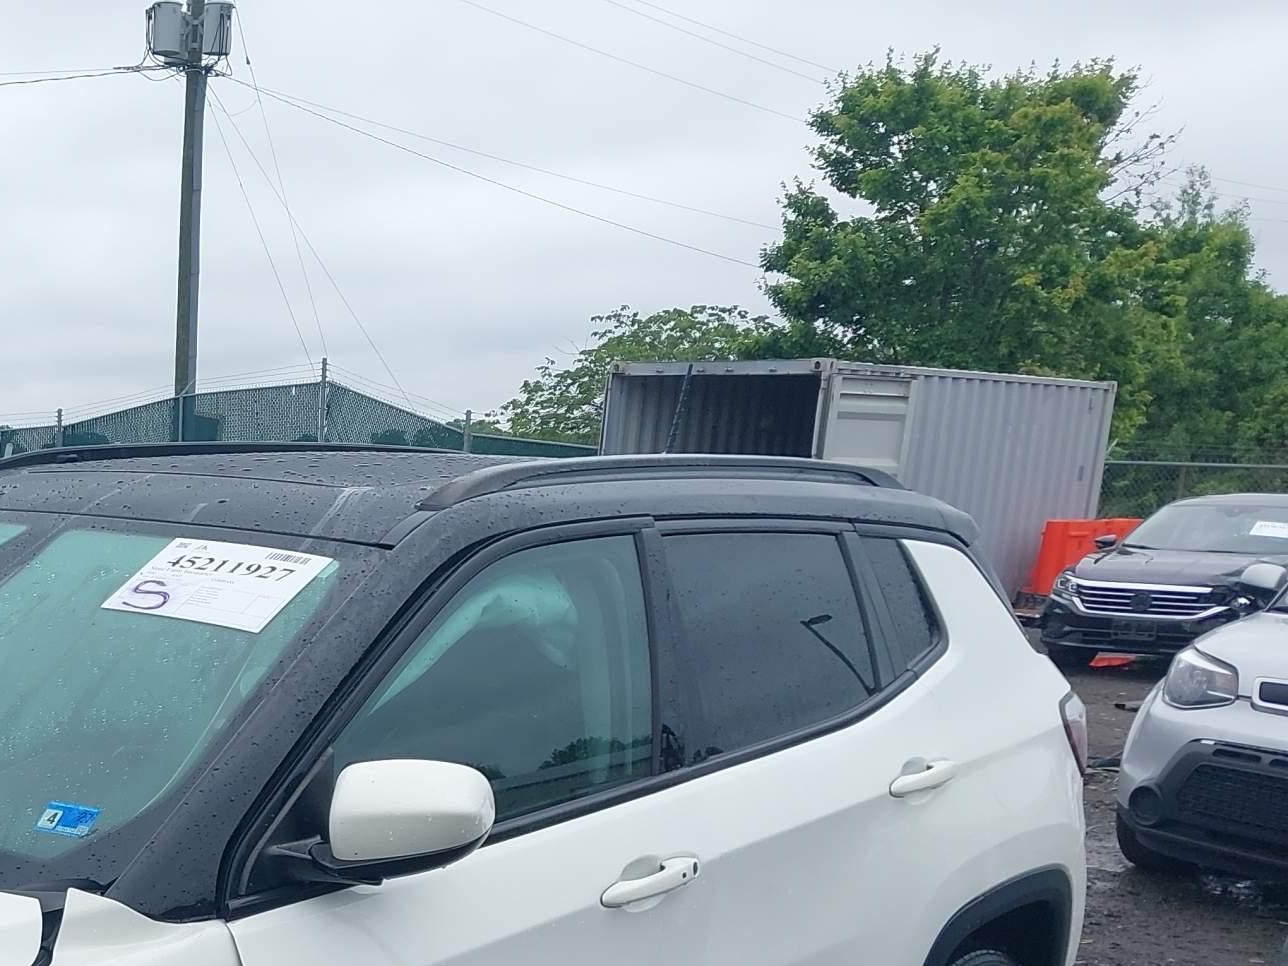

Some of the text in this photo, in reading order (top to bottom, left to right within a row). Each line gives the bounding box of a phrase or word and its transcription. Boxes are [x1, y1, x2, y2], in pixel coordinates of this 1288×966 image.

[167, 554, 296, 582] 45211927
[122, 579, 170, 610] S
[47, 813, 58, 824] 4
